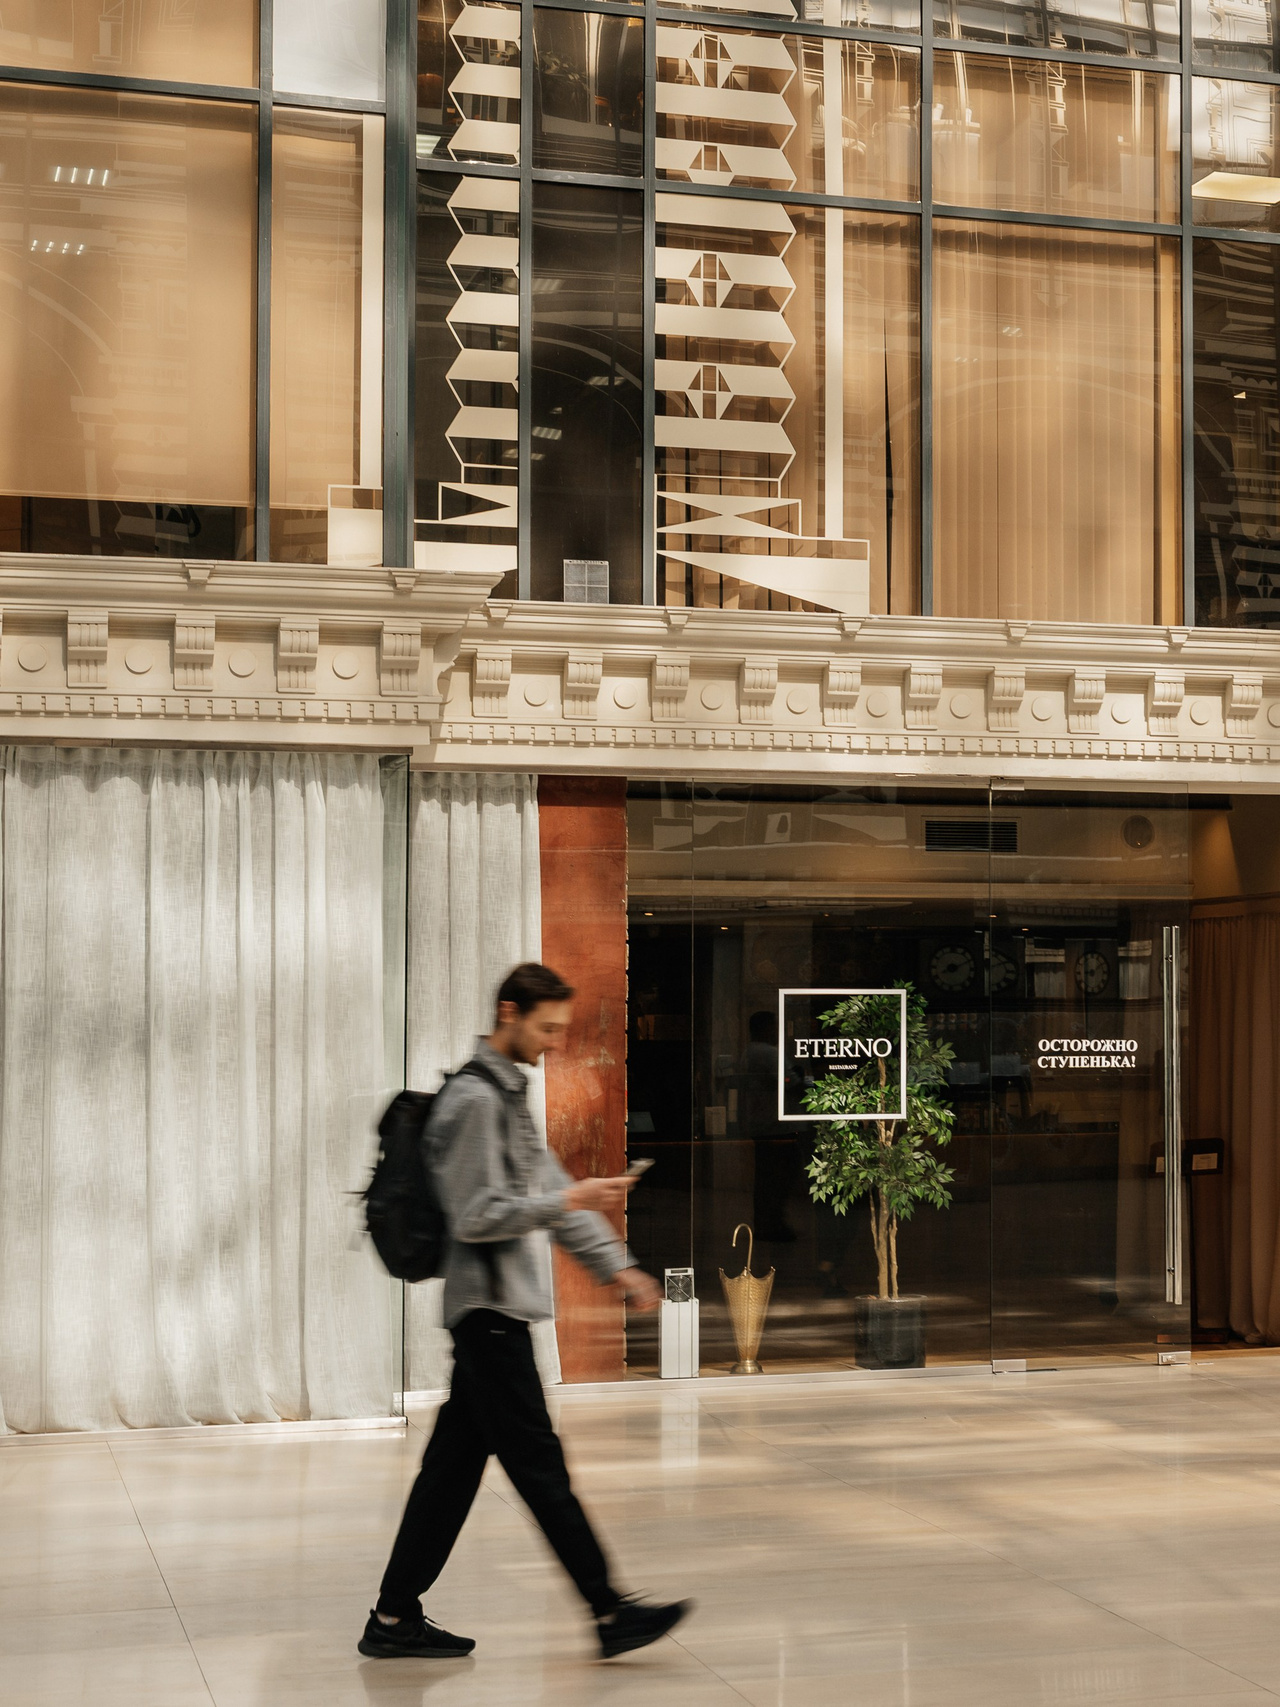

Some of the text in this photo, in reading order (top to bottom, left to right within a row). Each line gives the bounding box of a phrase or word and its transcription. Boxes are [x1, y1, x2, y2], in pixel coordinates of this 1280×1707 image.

[794, 1038, 893, 1058] ETERNO
[1037, 1039, 1138, 1052] ОСТОРОЖНО
[1037, 1055, 1136, 1069] СТУПЕНЬКА!
